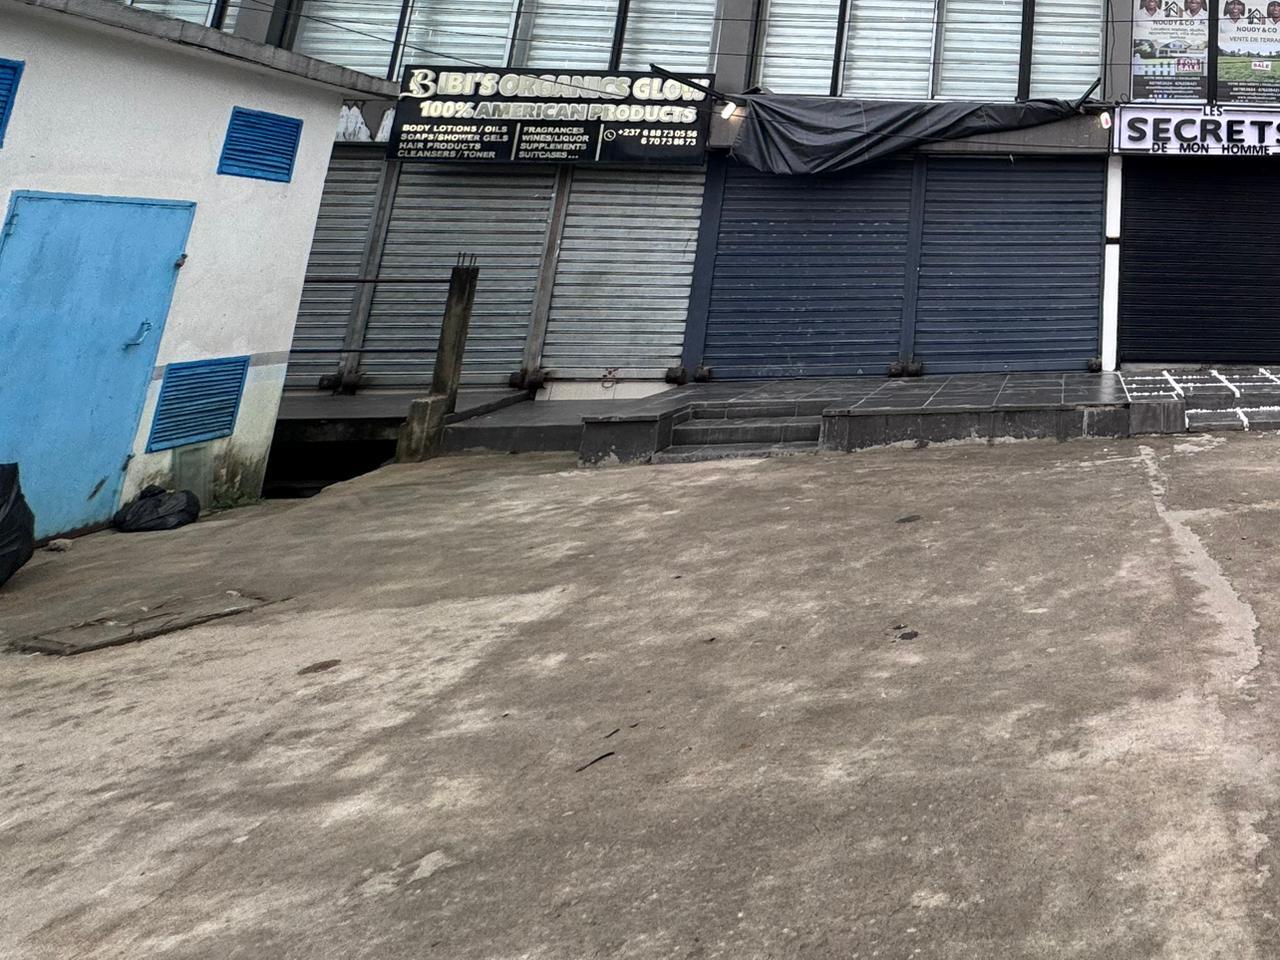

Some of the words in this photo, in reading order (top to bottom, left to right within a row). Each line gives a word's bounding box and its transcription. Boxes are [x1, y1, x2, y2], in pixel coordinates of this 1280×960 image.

[401, 69, 500, 98] BIBI'S
[499, 73, 632, 99] ORGANICS
[632, 77, 710, 101] GLOW
[419, 100, 475, 118] 100%
[473, 101, 589, 121] AMERICAN
[588, 103, 697, 123] PRODUCTS
[1203, 105, 1223, 117] LES
[402, 124, 431, 132] BODY
[433, 125, 477, 133] LOTIONS
[523, 126, 584, 134] FRAGRANCES
[401, 133, 480, 141] SOAPS/SHOWER
[426, 142, 482, 150] PRODUCTS
[1152, 142, 1168, 153] DE
[1179, 143, 1209, 154] MON
[1222, 144, 1270, 156] HOMME
[397, 150, 457, 158] CLEANSERS
